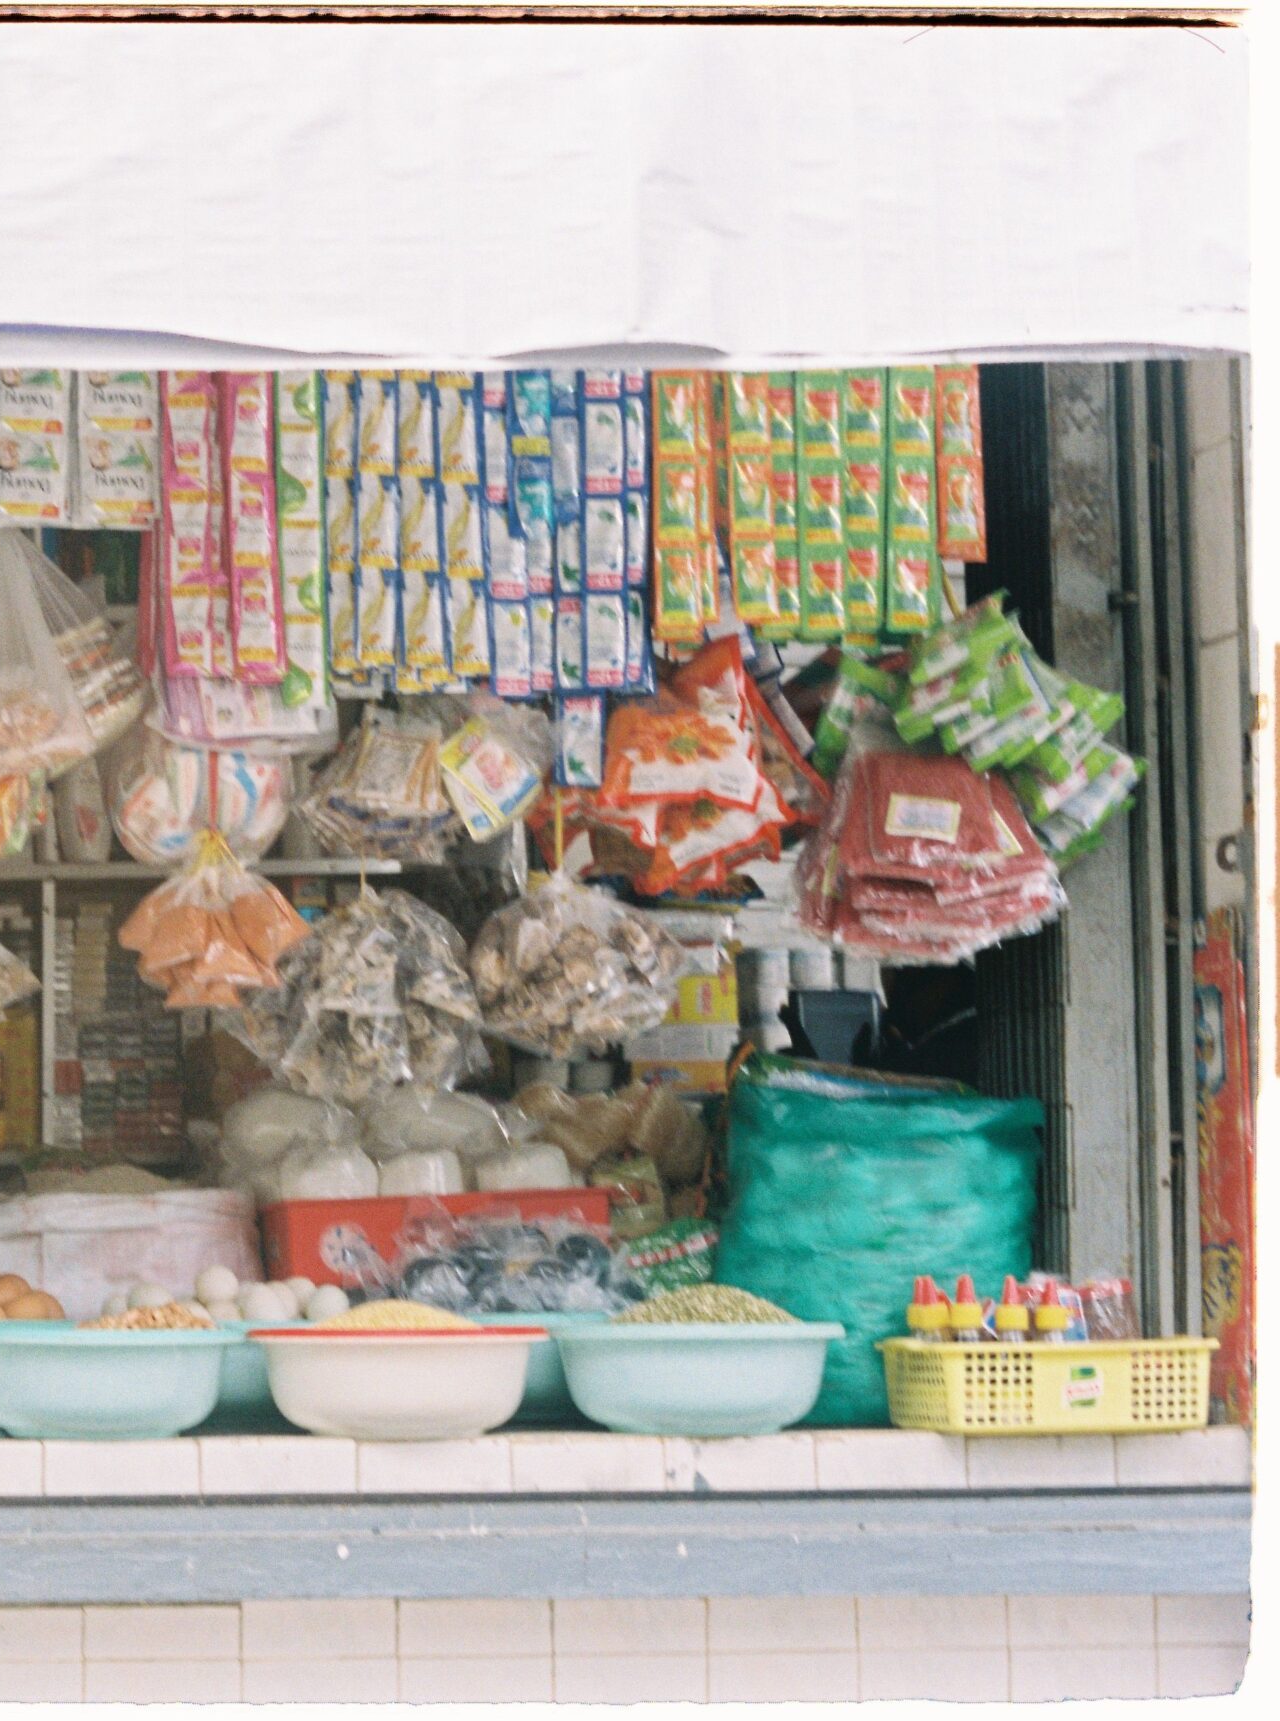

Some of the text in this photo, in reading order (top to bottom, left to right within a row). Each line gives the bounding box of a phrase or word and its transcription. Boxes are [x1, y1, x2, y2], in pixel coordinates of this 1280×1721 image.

[4, 388, 54, 409] Downy
[92, 388, 142, 407] Downy
[0, 472, 50, 492] Downy
[95, 473, 145, 489] Downy
